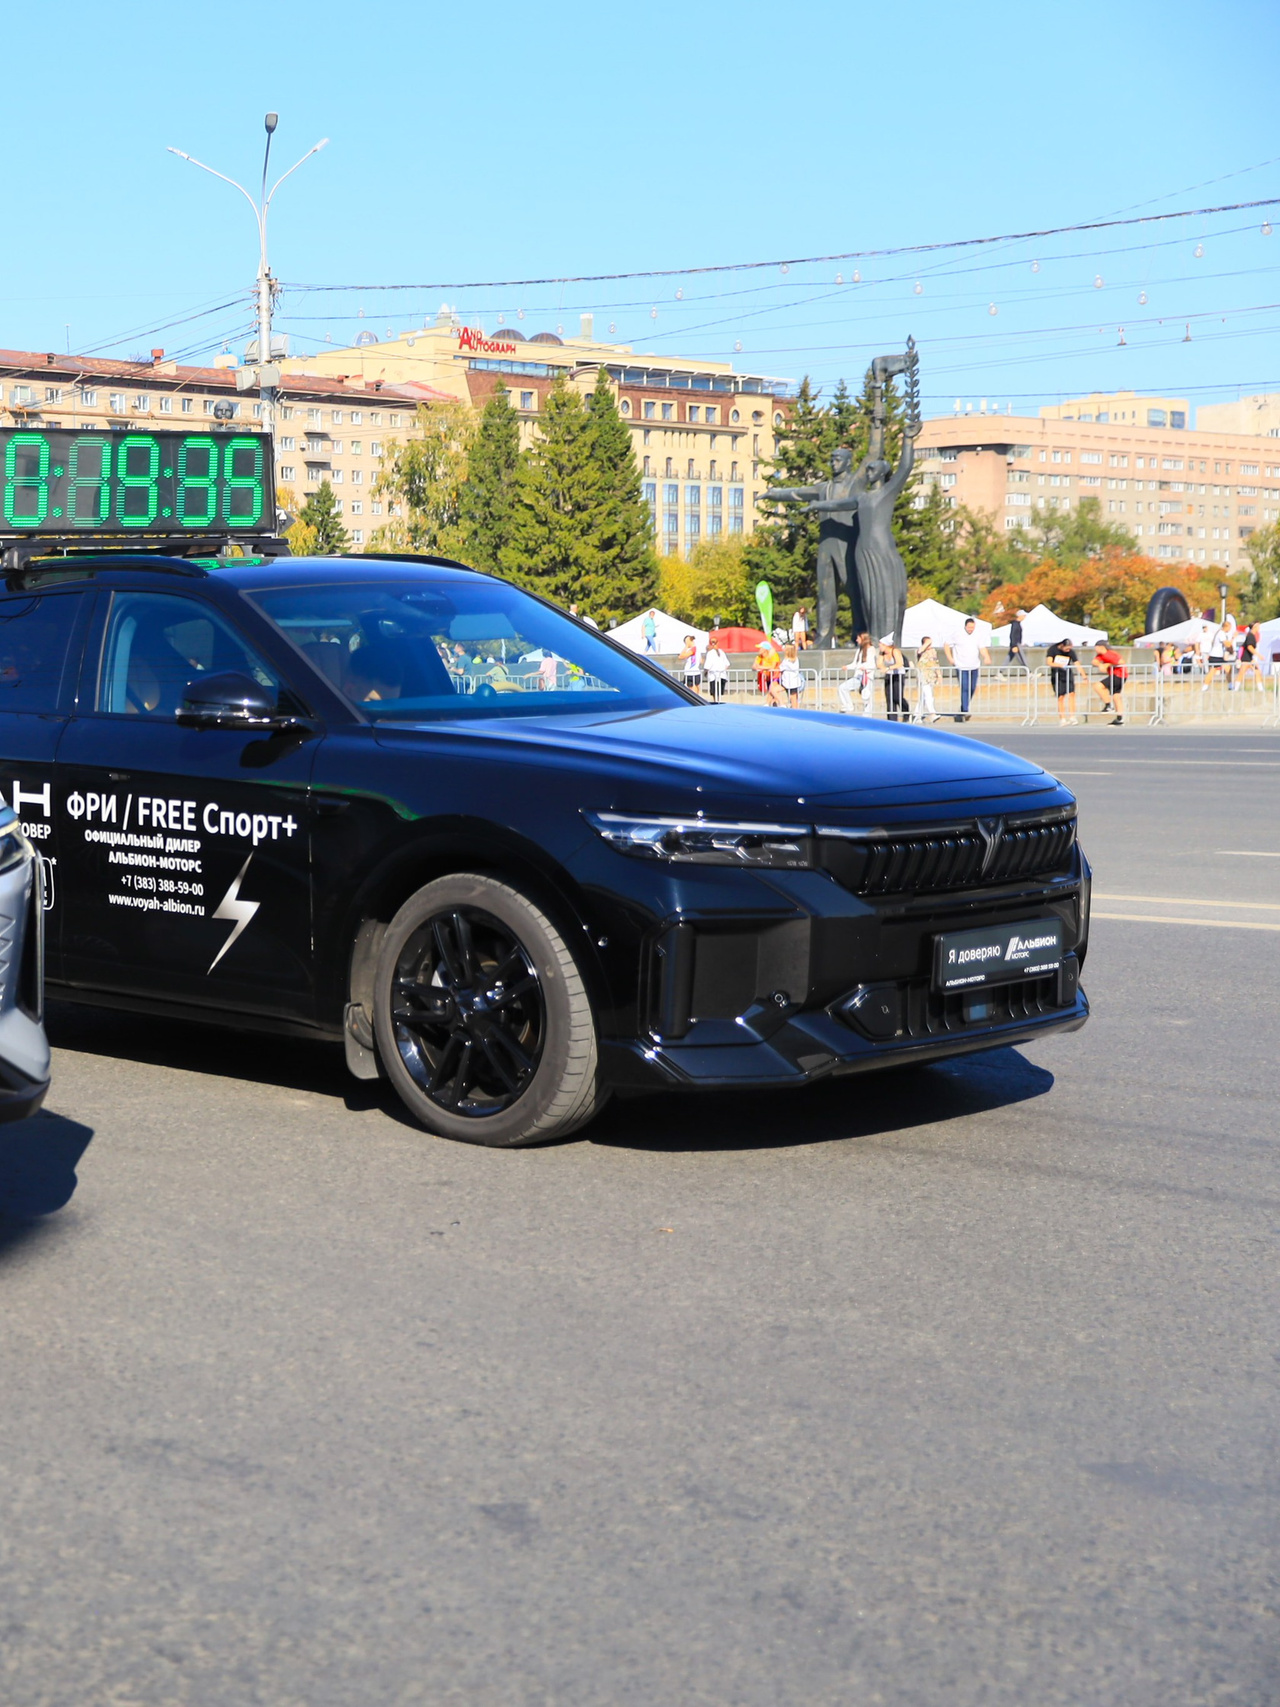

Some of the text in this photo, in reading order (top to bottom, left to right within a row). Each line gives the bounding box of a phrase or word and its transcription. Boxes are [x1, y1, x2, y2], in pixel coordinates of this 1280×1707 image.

[459, 327, 517, 355] AUTOGRAPH
[66, 791, 117, 823] ФРИ
[138, 796, 197, 831] FREE
[203, 803, 298, 846] Спорт+
[85, 829, 201, 853] ОФИЦИАЛЬНЫЙ ДИЛЕР
[108, 851, 202, 873] АЛЬБИОН-МОТОРС
[121, 875, 204, 896] +7 (383) 388-59-00
[108, 894, 205, 916] www.voyah-albion.ru
[1017, 935, 1057, 950] АЛЬБИОН
[948, 945, 1001, 964] Я доверяю
